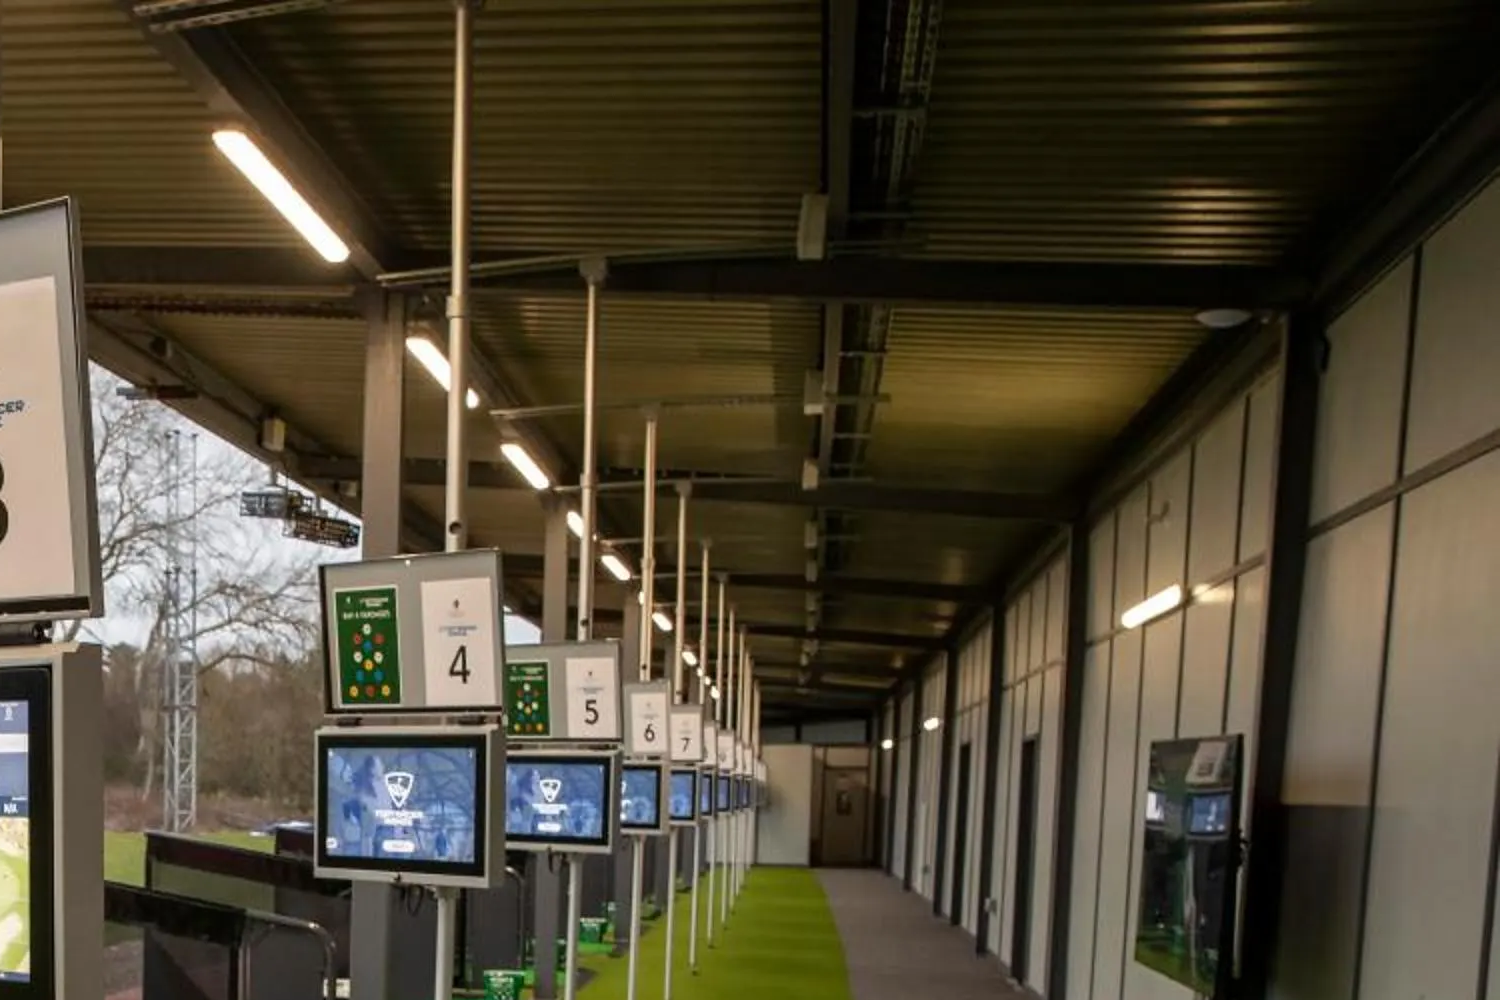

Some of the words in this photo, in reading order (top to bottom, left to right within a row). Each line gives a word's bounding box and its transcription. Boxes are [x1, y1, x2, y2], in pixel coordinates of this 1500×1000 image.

[448, 645, 471, 684] 4
[584, 699, 599, 725] 5
[644, 723, 655, 742] 6
[680, 737, 692, 752] 7
